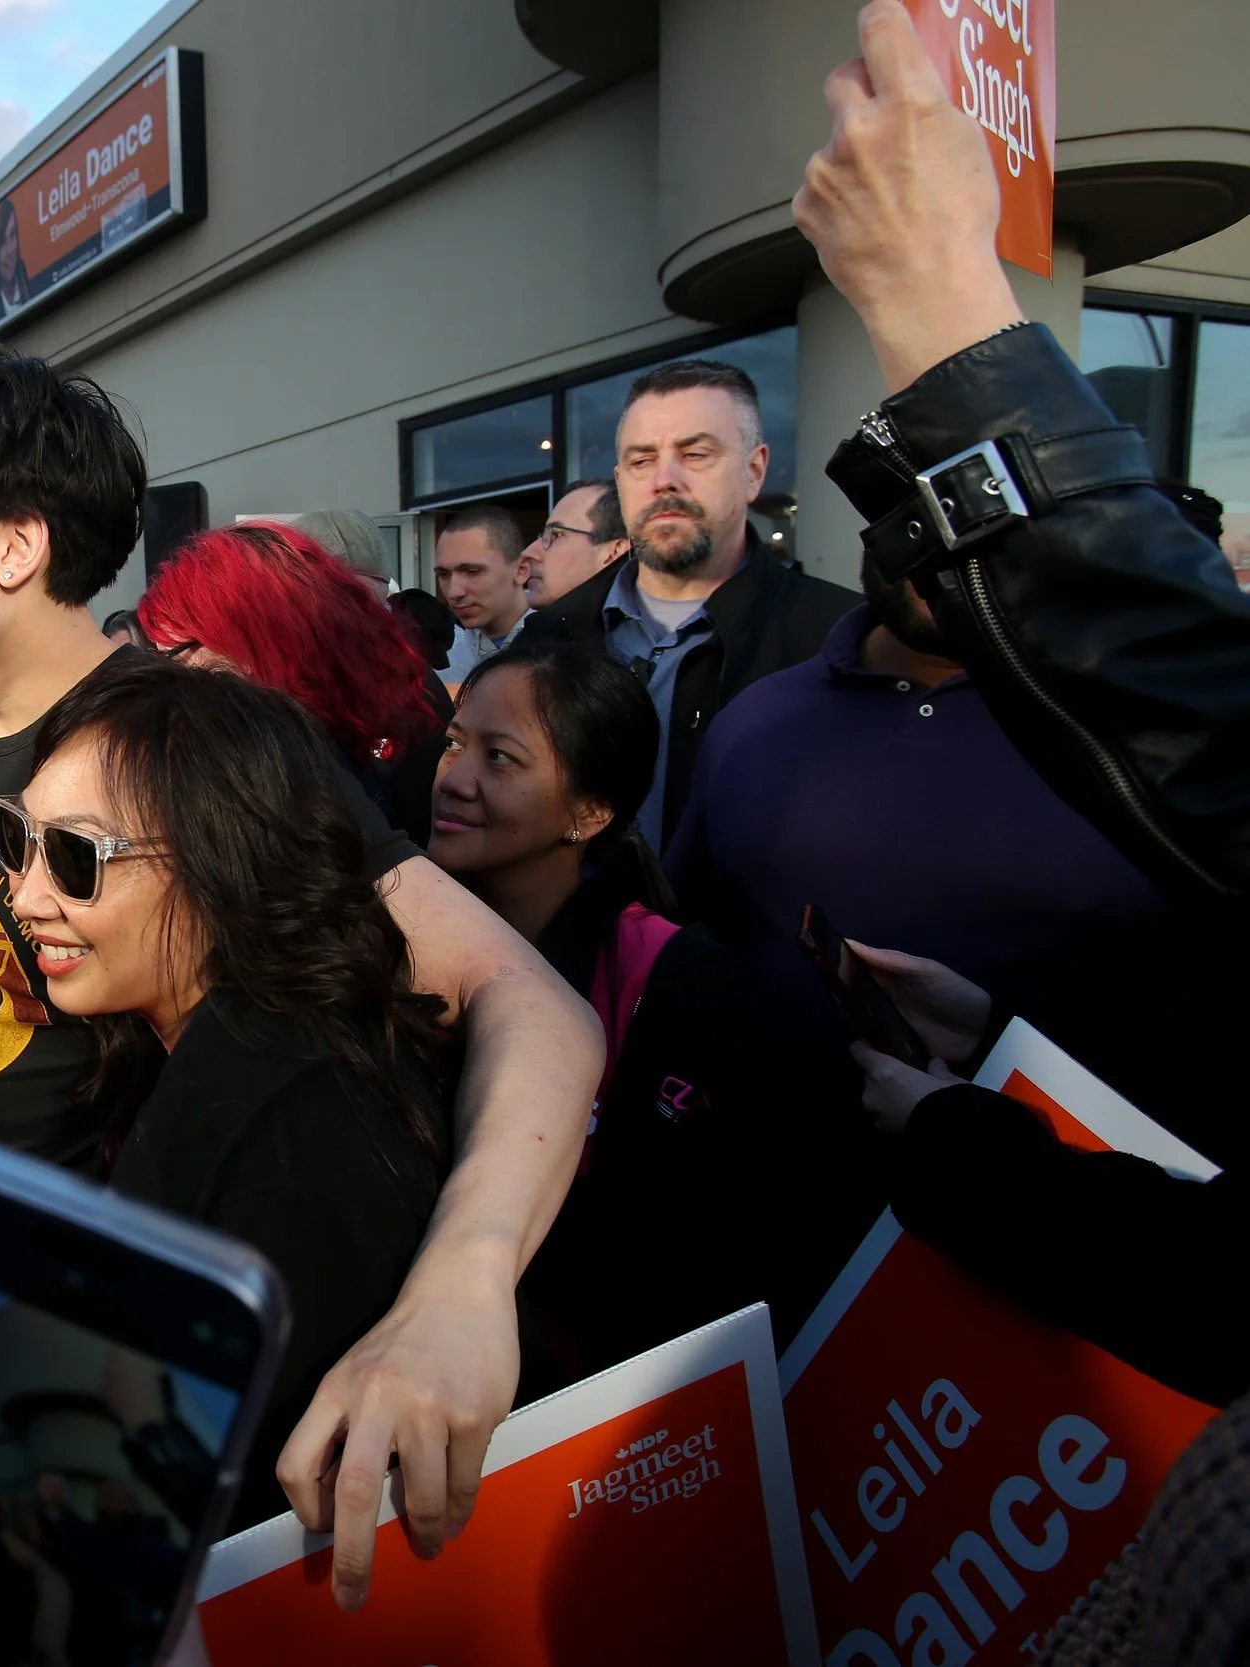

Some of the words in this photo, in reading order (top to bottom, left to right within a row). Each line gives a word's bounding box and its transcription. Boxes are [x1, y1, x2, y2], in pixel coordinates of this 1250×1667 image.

[958, 16, 1036, 178] Singh
[37, 167, 81, 225] Leila
[86, 113, 153, 188] Dance
[567, 1424, 718, 1518] Jagmeet
[629, 1429, 669, 1455] NDP
[630, 1455, 723, 1513] Singh
[810, 1378, 982, 1583] Leila
[824, 1414, 1128, 1667] ance
